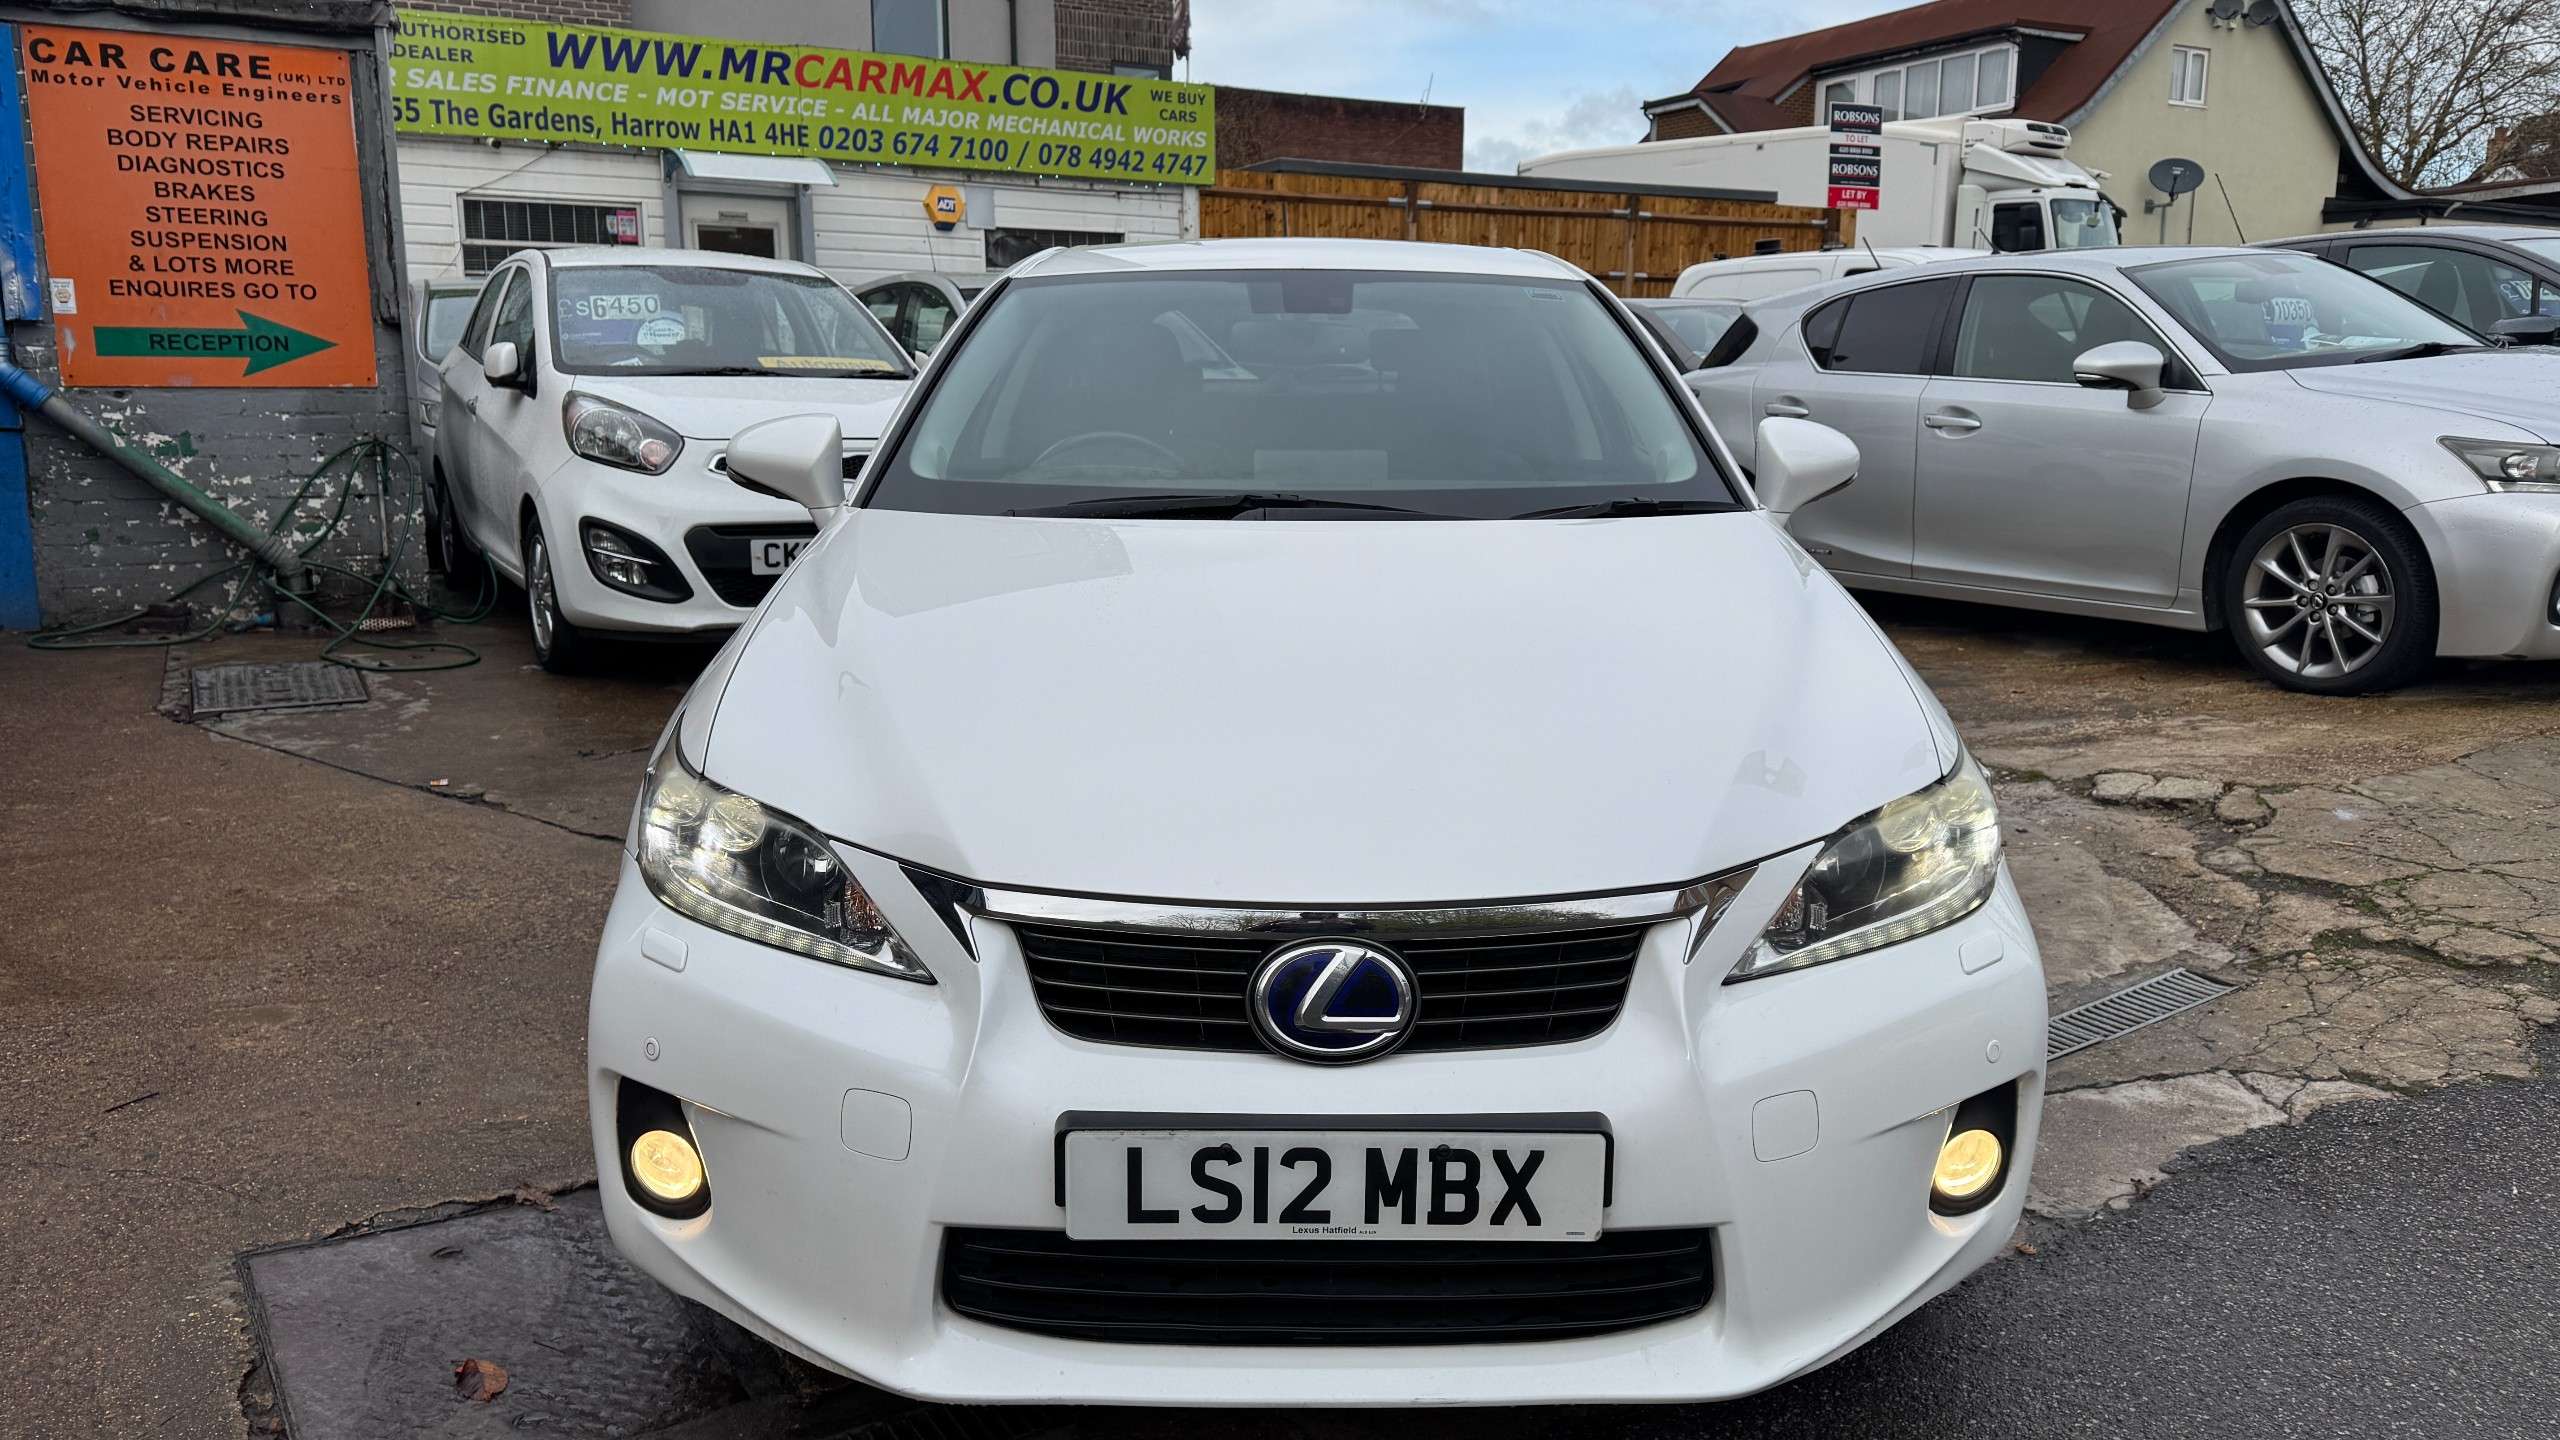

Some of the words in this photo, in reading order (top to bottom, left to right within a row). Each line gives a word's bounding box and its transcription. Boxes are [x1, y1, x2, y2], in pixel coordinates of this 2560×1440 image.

[29, 38, 127, 70] CAR
[150, 47, 272, 80] CARE
[278, 72, 311, 85] (UK)
[318, 75, 346, 86] LTD
[393, 43, 475, 63] DEALER
[547, 31, 1132, 115] WWW.MRCARMAX.CO.UK
[31, 69, 105, 87] Motor
[116, 74, 210, 95] Vehicle
[222, 82, 342, 104] Engineers
[406, 67, 497, 94] SALES
[506, 75, 629, 102] FINANCE
[656, 86, 714, 108] MOT
[720, 91, 828, 117] SERVICE
[852, 102, 894, 123] ALL
[902, 106, 980, 130] MAJOR
[986, 112, 1126, 142] MECHANICAL
[1133, 126, 1207, 148] WORKS
[1151, 89, 1173, 103] WE
[1177, 91, 1206, 106] BUY
[130, 105, 263, 129] SERVICING
[1159, 108, 1197, 123] CARS
[1833, 110, 1880, 123] ROBSONS
[107, 128, 177, 149] BODY
[186, 133, 289, 155] REPAIRS
[429, 98, 479, 127] The
[488, 102, 602, 139] Gardens,
[612, 111, 700, 141] Harrow
[710, 117, 757, 144] HA1
[765, 122, 810, 148] 4HE
[819, 125, 884, 153] 0203
[893, 131, 939, 157] 674
[949, 136, 1009, 162] 7100
[1038, 143, 1081, 168] 078
[1089, 147, 1144, 173] 4942
[1152, 152, 1207, 177] 4747
[1845, 134, 1856, 143] TO
[1857, 135, 1870, 143] LET
[117, 154, 285, 179] DIAGNOSTICS
[1832, 163, 1879, 176] ROBSONS
[154, 181, 255, 202] BRAKES
[1842, 189, 1855, 199] LET
[1857, 190, 1868, 199] BY
[937, 198, 955, 211] ADT
[145, 205, 268, 227] STEERING
[131, 230, 287, 252] SUSPENSION
[129, 255, 145, 272] &
[154, 255, 217, 274] LOTS
[225, 257, 295, 276] MORE
[109, 279, 236, 298] ENQUIRES
[243, 282, 279, 300] GO
[286, 283, 317, 300] TO
[149, 333, 289, 352] RECEPTION
[764, 542, 811, 568] CK
[1127, 1143, 1332, 1224] LS12
[1364, 1144, 1545, 1226] MBX
[1292, 1226, 1320, 1234] Lexus
[1322, 1226, 1357, 1234] Hatfield
